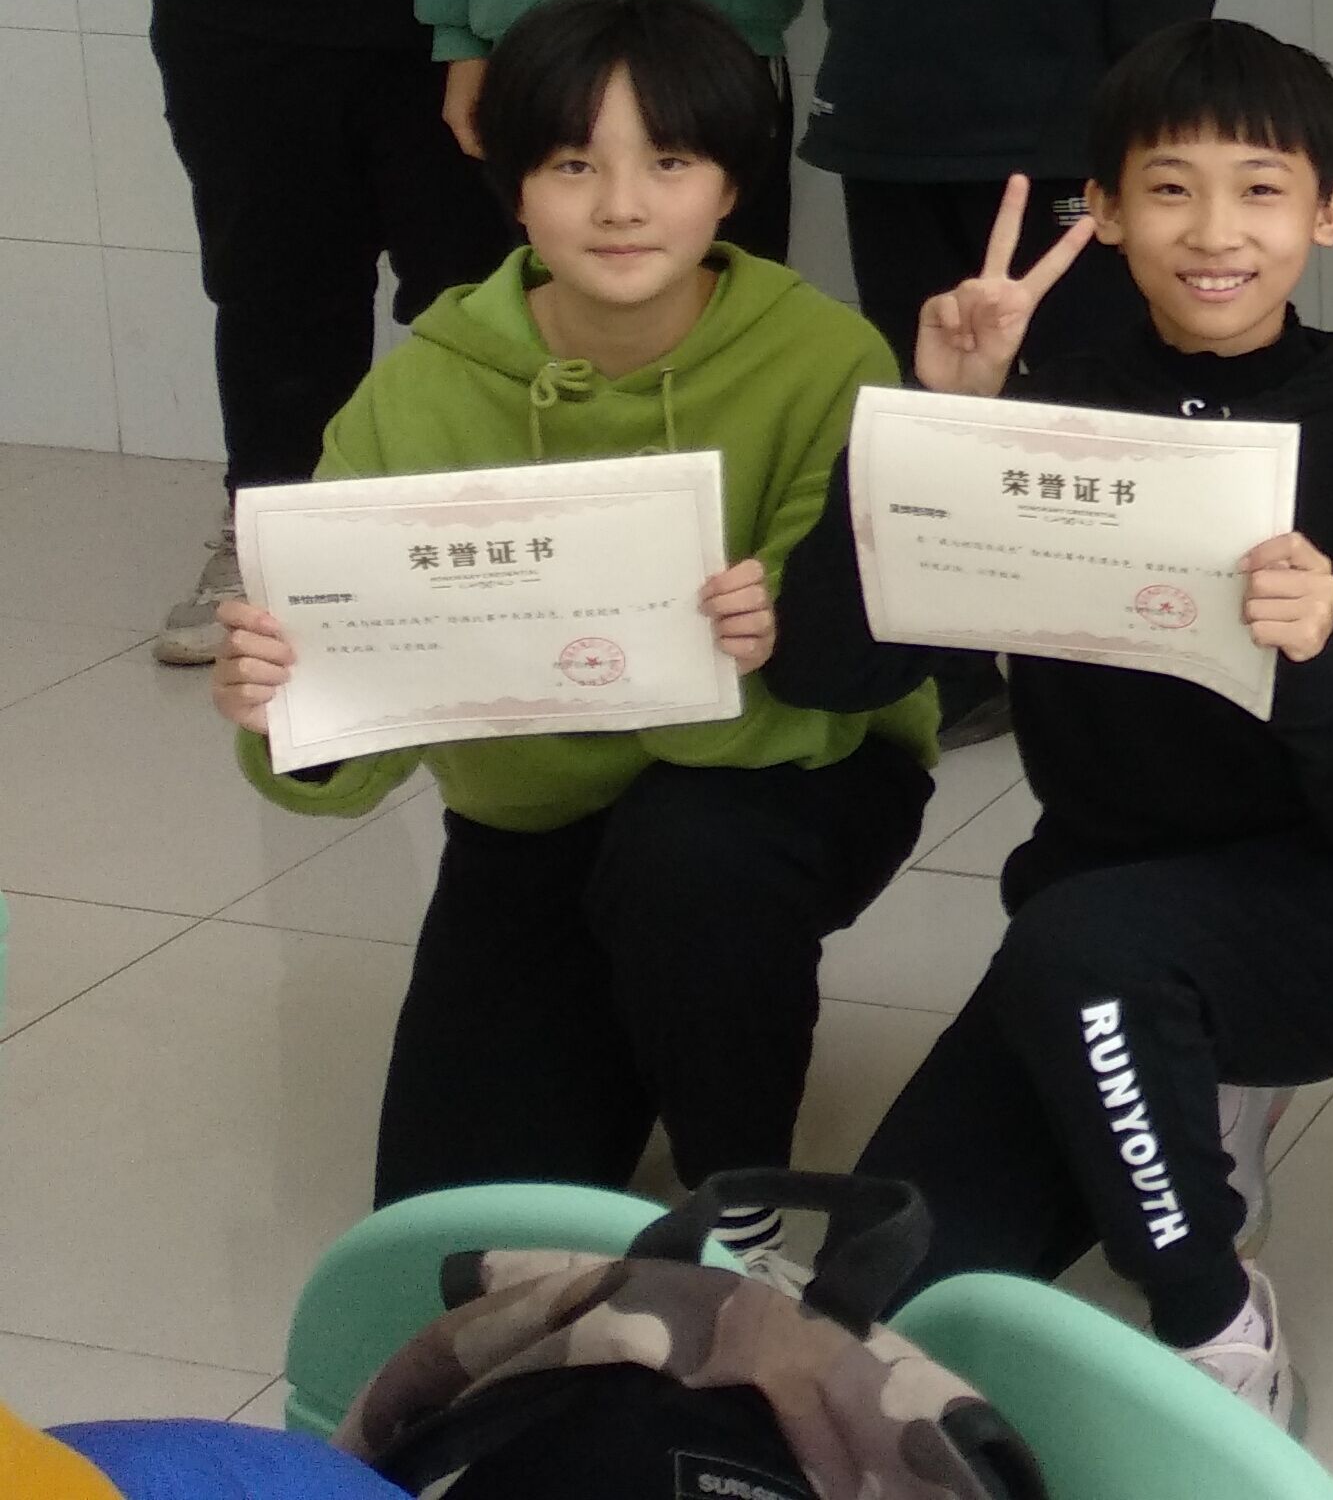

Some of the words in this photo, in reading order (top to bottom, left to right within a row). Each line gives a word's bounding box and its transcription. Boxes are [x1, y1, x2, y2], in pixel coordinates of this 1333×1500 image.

[1001, 469, 1137, 505] 荣誉证书
[408, 536, 556, 571] 荣誉证书
[1080, 998, 1190, 1250] RUNYOUTH
